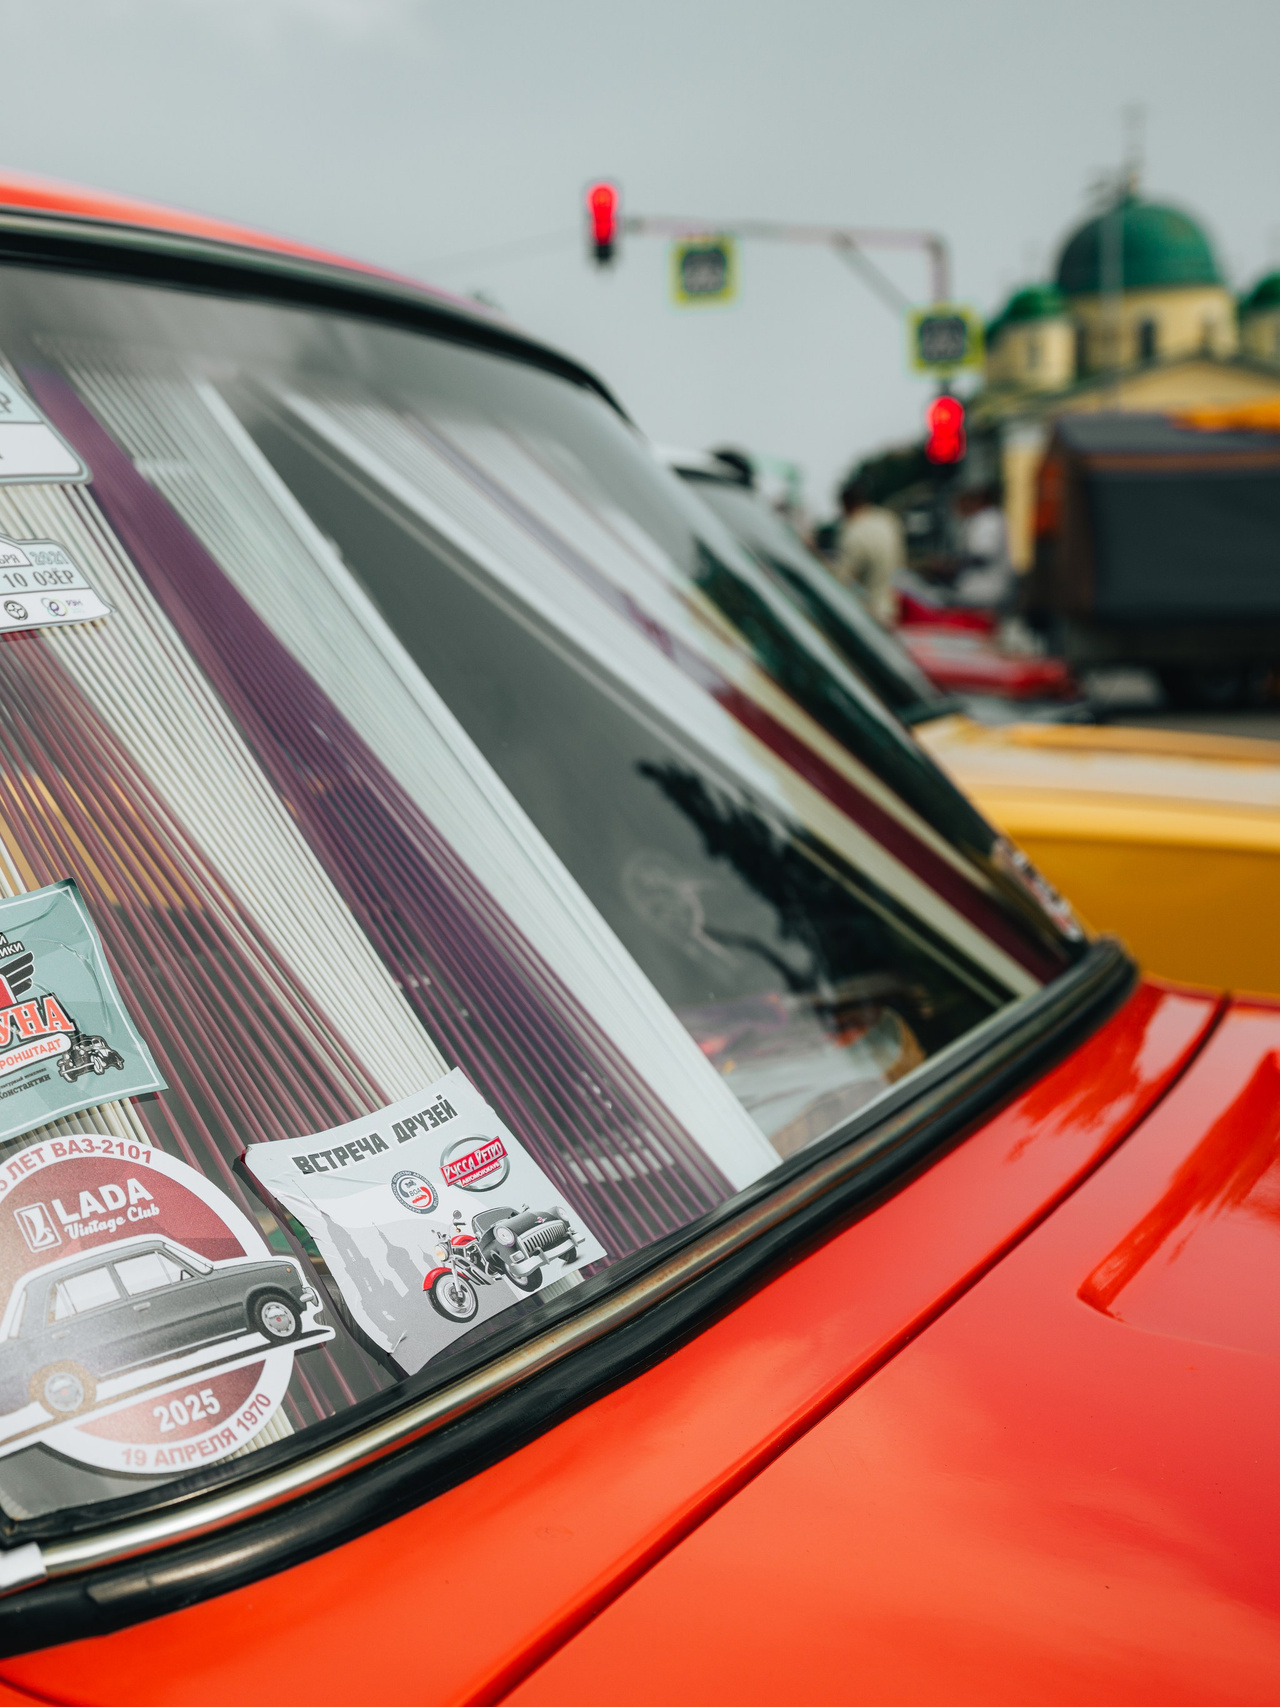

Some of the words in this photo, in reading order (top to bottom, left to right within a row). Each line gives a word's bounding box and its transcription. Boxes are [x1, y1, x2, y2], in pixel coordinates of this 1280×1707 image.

[3, 572, 28, 588] 10
[33, 568, 75, 586] ОЗЁР
[292, 1132, 389, 1175] ВСТРЕЧА
[391, 1094, 458, 1144] ДРУЗЕЙ
[7, 1147, 48, 1179] ЛЕТ
[50, 1138, 153, 1164] ВАЗ-2101
[51, 1178, 154, 1224] LADA
[64, 1211, 127, 1240] Vintage
[126, 1202, 160, 1223] Club
[122, 1448, 147, 1467] 19
[154, 1429, 237, 1468] АПРЕЛЯ
[235, 1392, 272, 1432] 1970
[153, 1388, 221, 1433] 2025
